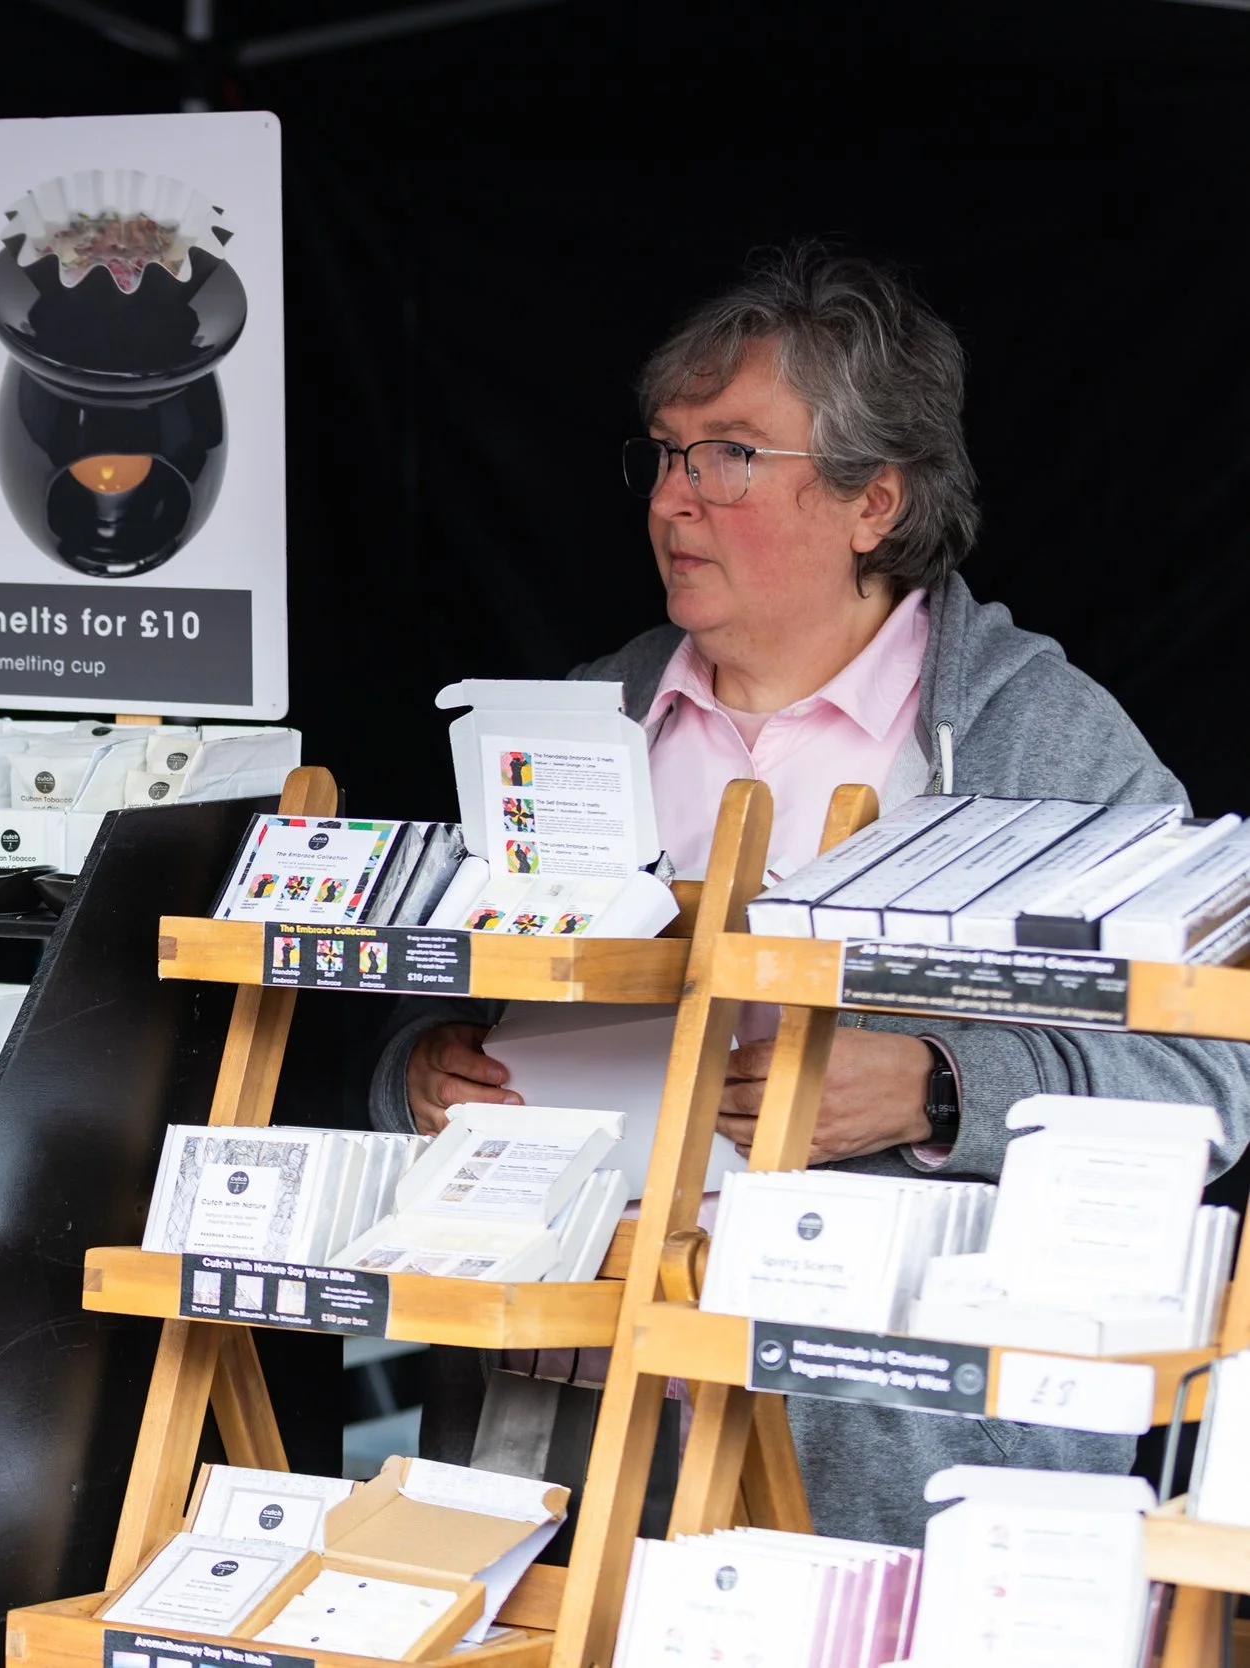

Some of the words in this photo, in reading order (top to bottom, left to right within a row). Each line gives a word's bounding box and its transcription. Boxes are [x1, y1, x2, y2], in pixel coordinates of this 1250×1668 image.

[81, 608, 127, 636] for
[139, 609, 200, 640] £10
[0, 654, 65, 677] melting
[70, 659, 106, 677] cup
[20, 795, 42, 803] Cuban
[43, 795, 73, 804] Tobacco
[9, 855, 36, 863] Tobacco
[288, 852, 315, 860] Embrace
[316, 853, 348, 861] Collection
[280, 924, 295, 933] The
[296, 925, 332, 935] Embrace
[334, 926, 377, 937] Collection
[271, 968, 300, 977] Friendship
[324, 970, 335, 978] Self
[273, 977, 298, 985] Embrace
[316, 978, 341, 987] Embrace
[423, 975, 438, 983] per
[438, 974, 454, 983] box
[359, 980, 386, 989] Embrace
[201, 1198, 223, 1207] Cutch
[243, 1202, 267, 1210] Nature
[202, 1257, 232, 1270] Cutch
[234, 1261, 252, 1272] with
[254, 1262, 286, 1275] Nature
[287, 1265, 305, 1279] Soy
[305, 1268, 329, 1280] Wax
[330, 1270, 355, 1283] Melts
[191, 1305, 202, 1313] The
[262, 1508, 283, 1517] cutch
[216, 1562, 238, 1571] cutch
[134, 1636, 204, 1658] Aromatherapy
[203, 1646, 222, 1661] Soy
[222, 1648, 245, 1663] Wax
[244, 1652, 272, 1667] Melts
